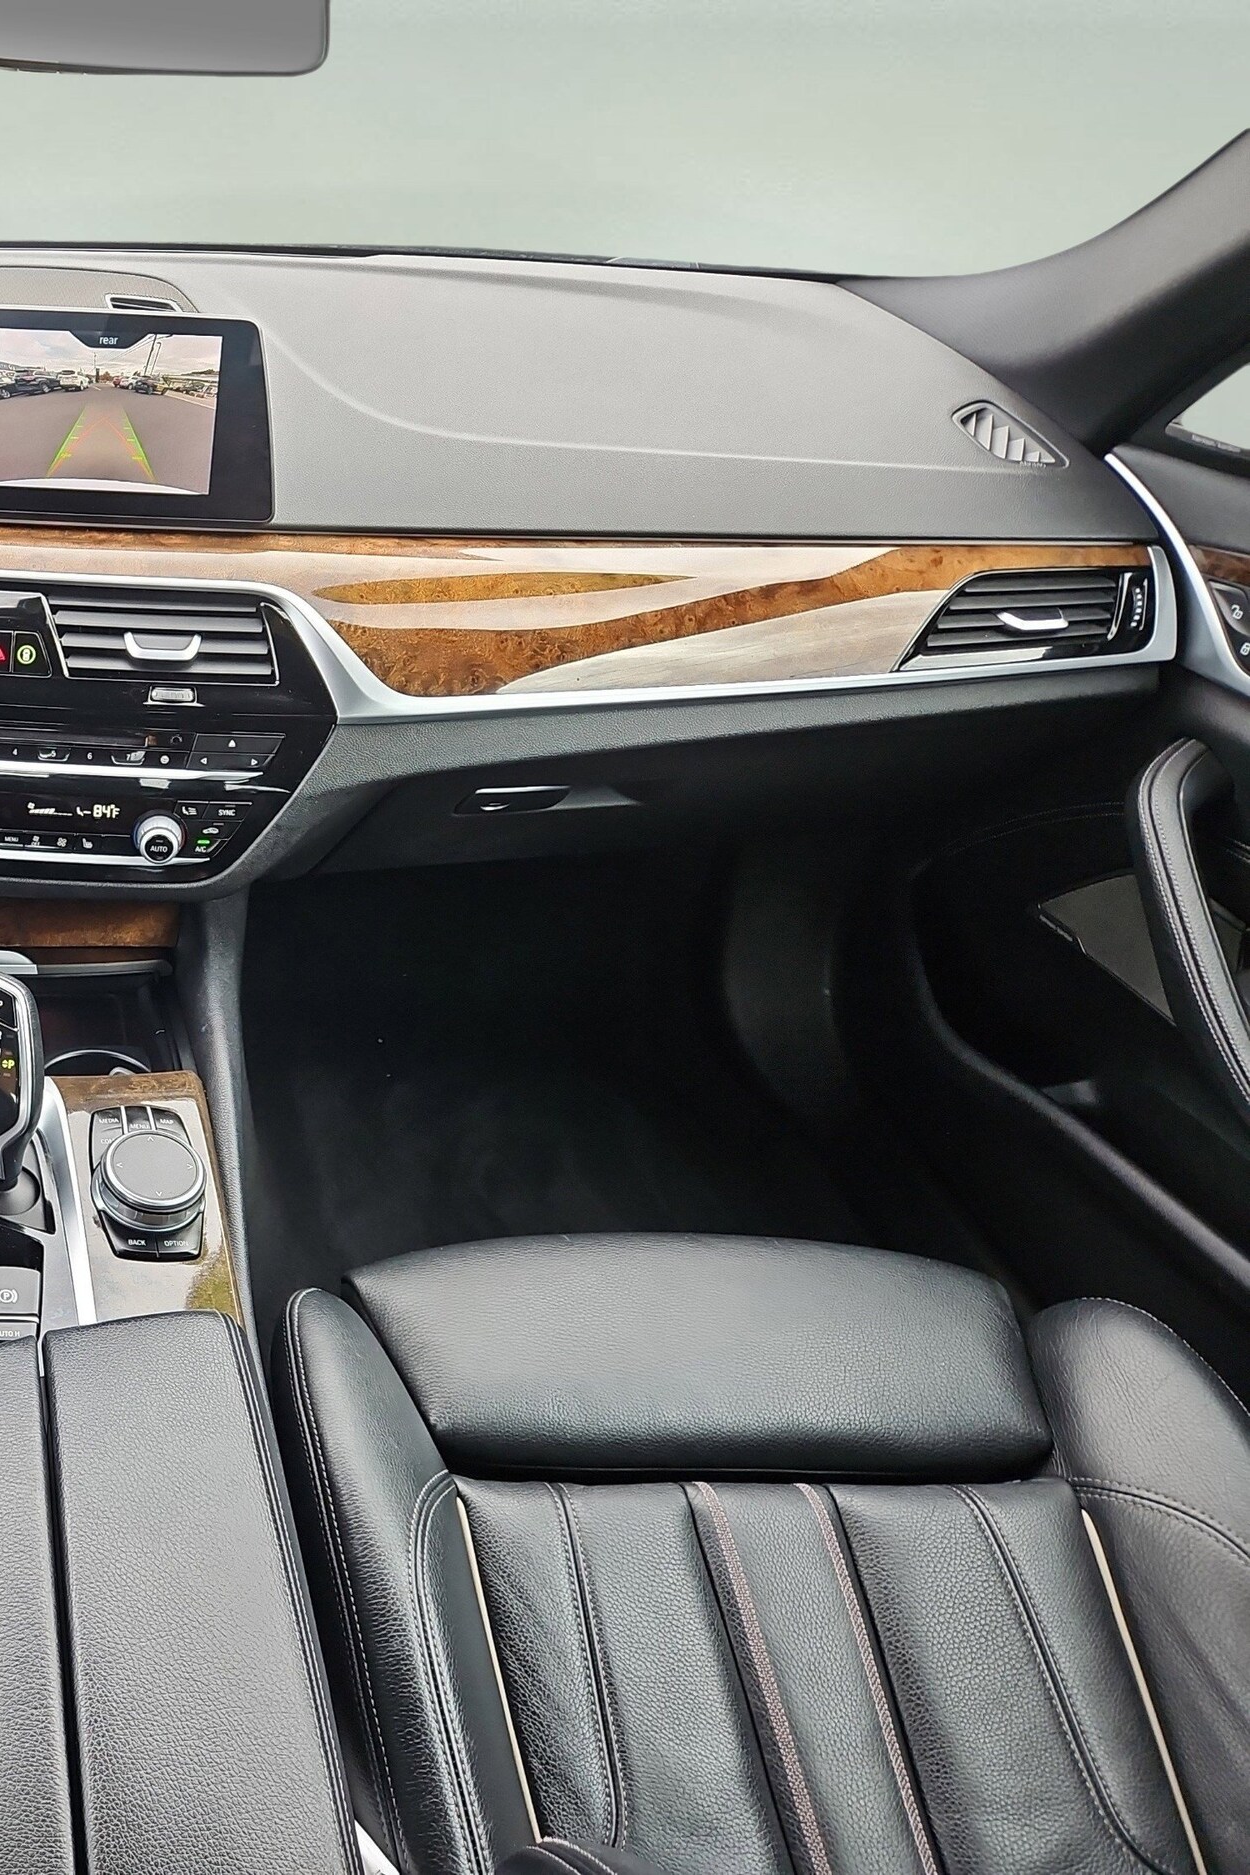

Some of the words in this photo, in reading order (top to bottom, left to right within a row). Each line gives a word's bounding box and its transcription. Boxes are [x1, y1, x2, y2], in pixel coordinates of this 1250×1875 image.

[99, 336, 119, 345] rear
[12, 748, 18, 756] 4
[51, 750, 57, 758] 5
[87, 752, 93, 760] 6
[217, 808, 236, 817] SYNC
[150, 844, 168, 853] AUTO
[195, 845, 207, 853] A/C
[98, 1117, 120, 1125] MEDIA
[127, 1238, 147, 1246] BACK
[163, 1239, 189, 1248] OPTION
[14, 1330, 21, 1338] H
